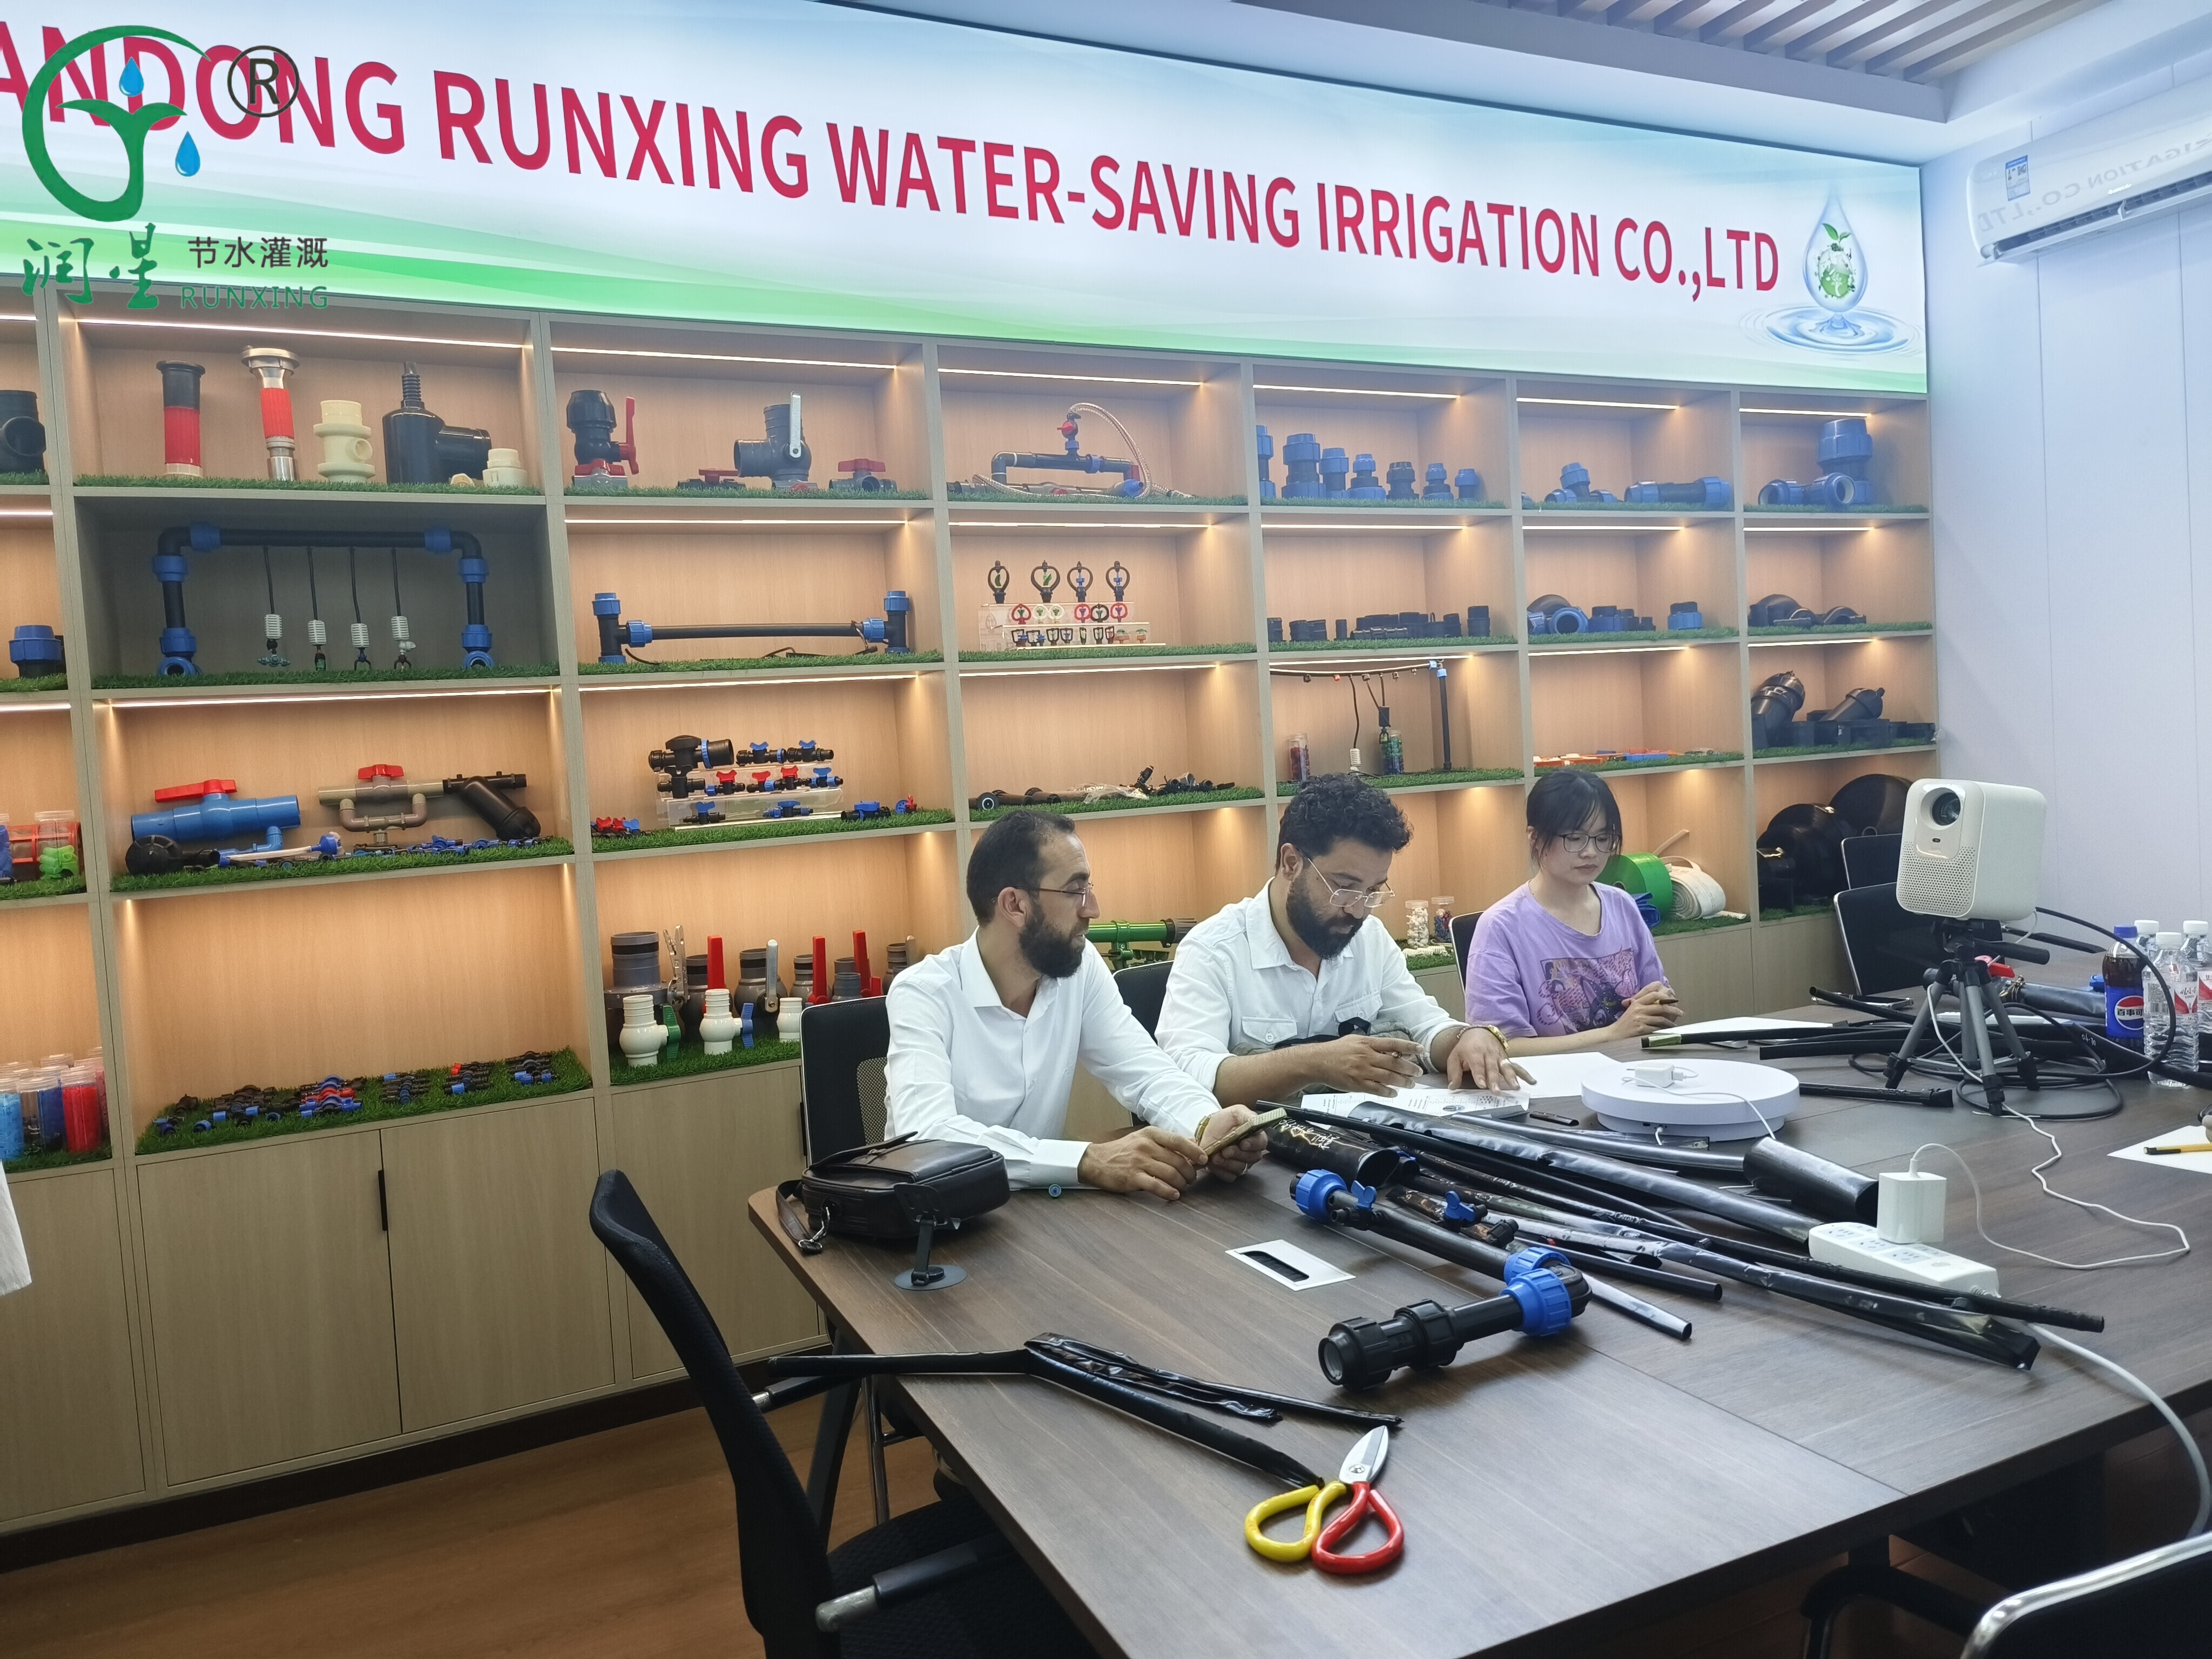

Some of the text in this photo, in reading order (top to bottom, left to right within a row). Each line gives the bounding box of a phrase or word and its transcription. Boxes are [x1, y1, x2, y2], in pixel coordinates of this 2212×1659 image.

[434, 70, 808, 199] RUNXING
[826, 122, 1300, 248] WATER-SAVING
[1317, 183, 1599, 277] IRRIGATION
[1614, 217, 1779, 301] CO.,LTD
[2117, 1008, 2143, 1016] 百事可
